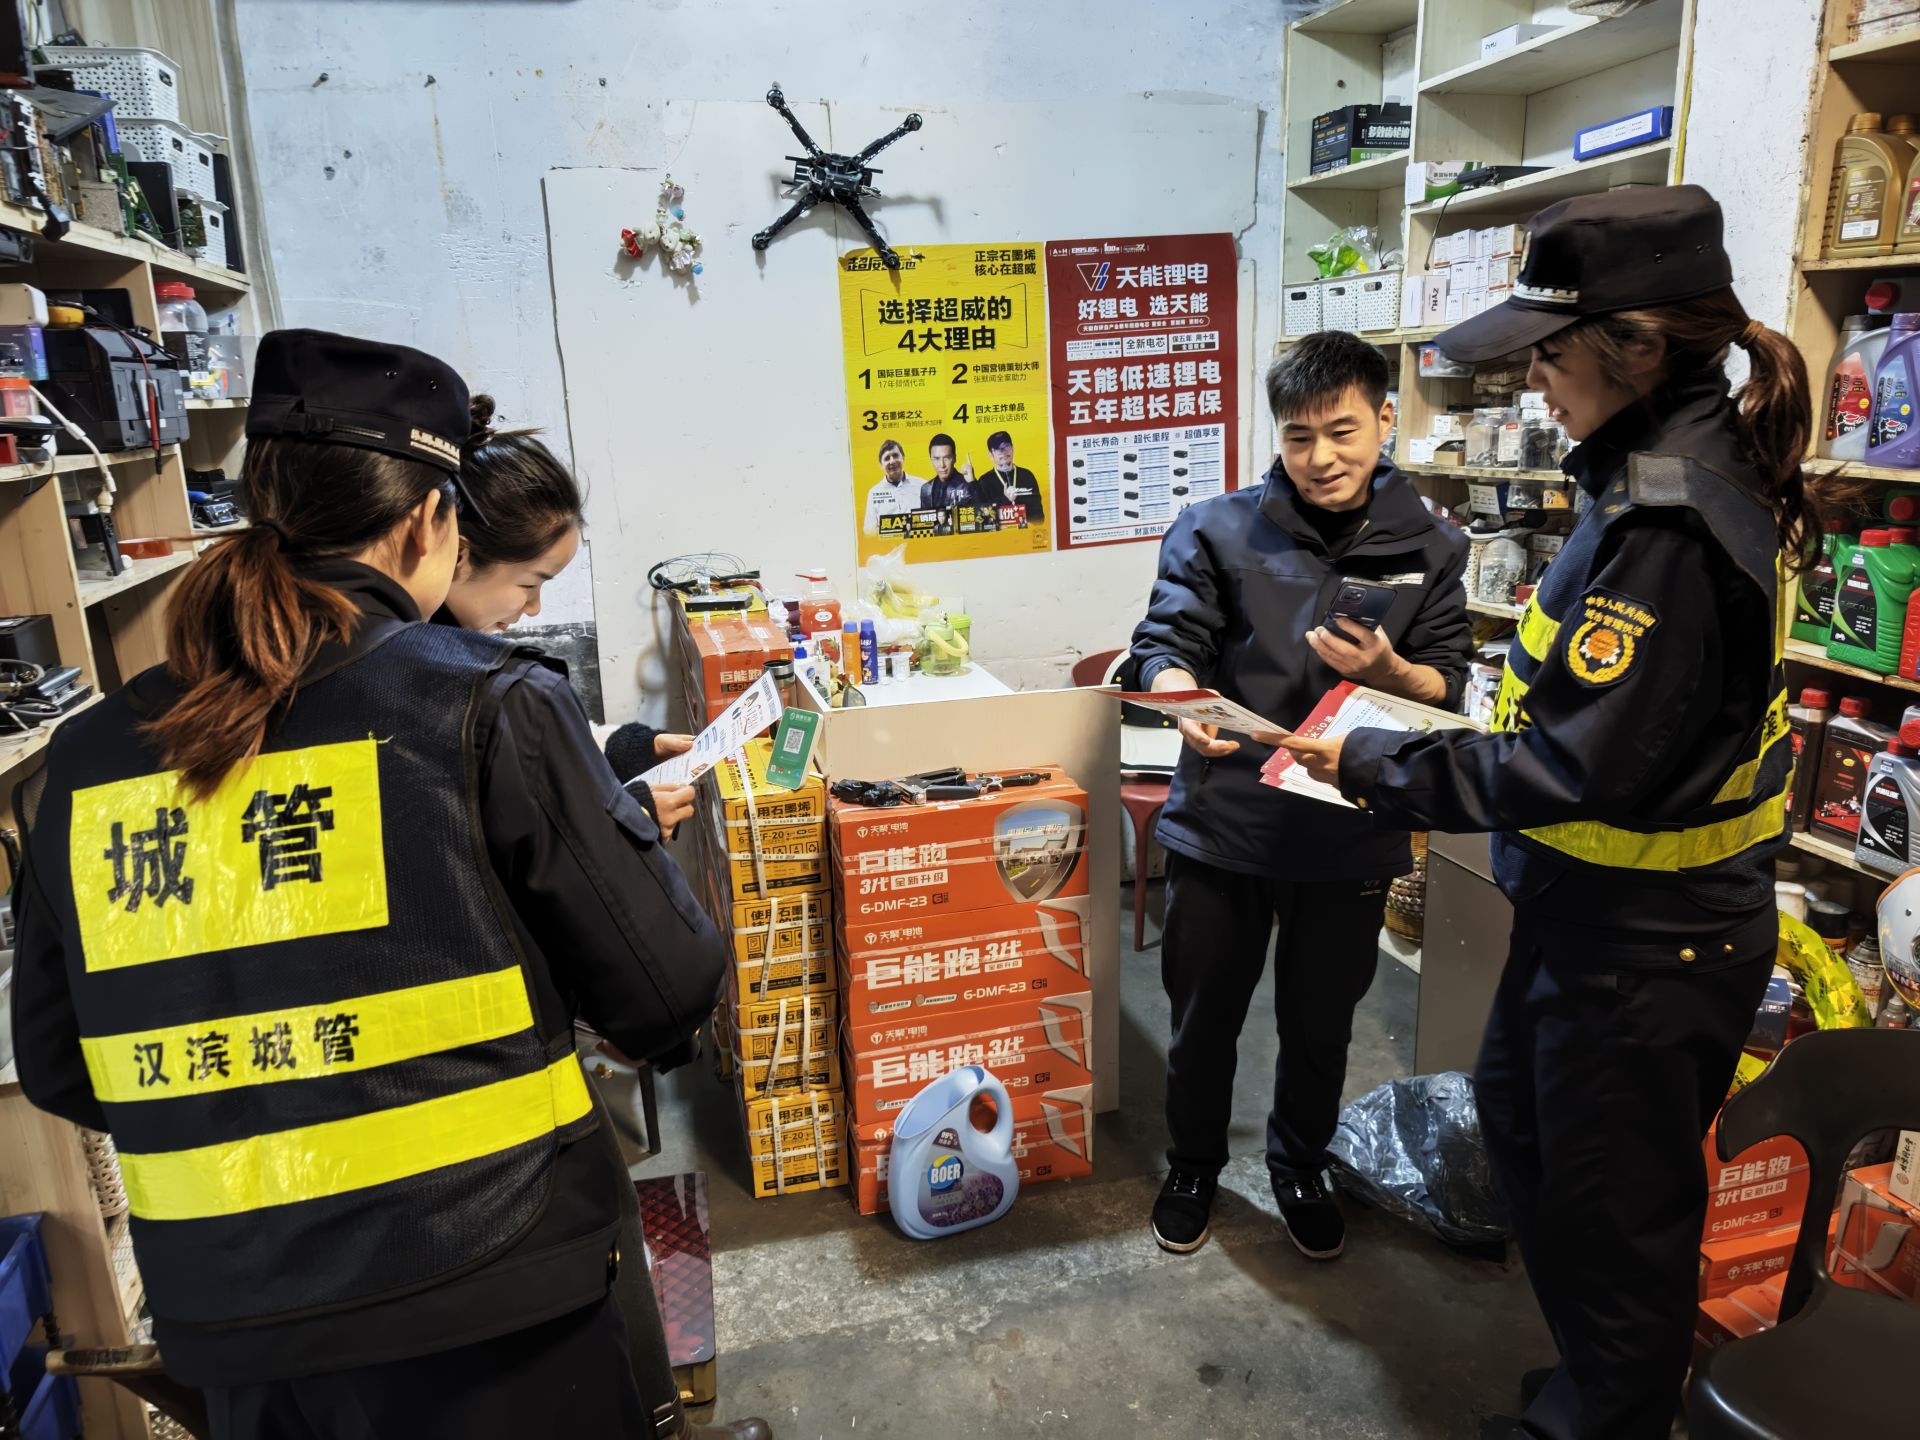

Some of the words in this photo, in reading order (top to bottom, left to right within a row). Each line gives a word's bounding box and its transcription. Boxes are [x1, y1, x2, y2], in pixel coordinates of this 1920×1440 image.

[847, 256, 916, 272] 超威池
[975, 249, 1036, 262] 正宗石墨烯
[974, 263, 1036, 276] 核心在超威
[1116, 263, 1209, 289] 天能锂电
[878, 295, 1012, 325] 选择超威的
[1078, 297, 1138, 321] 好锂电
[1149, 292, 1209, 316] 选天能
[898, 326, 995, 353] 4大理由
[1126, 336, 1166, 350] 全新电芯
[877, 367, 937, 379] 国际巨星甄子丹
[952, 363, 968, 384] 2
[973, 361, 1039, 373] 中国营销策划大师
[1067, 359, 1222, 396] 天能低速锂电
[858, 369, 871, 390] 1
[881, 410, 923, 421] 石墨烯之父
[952, 404, 969, 423] 4
[976, 403, 1025, 414] 四大王炸单品
[1069, 389, 1222, 424] 五年超长质保
[862, 410, 878, 431] 3
[1082, 436, 1119, 449] 超长寿命
[1133, 431, 1170, 444] 超长里程
[1184, 427, 1220, 440] 超值享受
[720, 669, 762, 683] 巨能跑
[103, 784, 334, 912] 城管
[859, 842, 948, 875] 巨能跑
[860, 876, 889, 894] 3代
[894, 871, 946, 888] 全新升级
[861, 895, 928, 914] 6-DMF-23
[866, 946, 981, 990] 巨能跑
[985, 939, 1022, 963] 3代
[964, 981, 1026, 1000] 6-DMF-23
[133, 1012, 360, 1088] 汉滨城管
[873, 1043, 984, 1089] 巨能跑
[988, 1036, 1024, 1057] 3代
[931, 1163, 961, 1184] BOER
[1719, 1156, 1791, 1190] 巨能跑
[1715, 1190, 1741, 1207] 3代
[1712, 1211, 1767, 1232] 6-DMF-23
